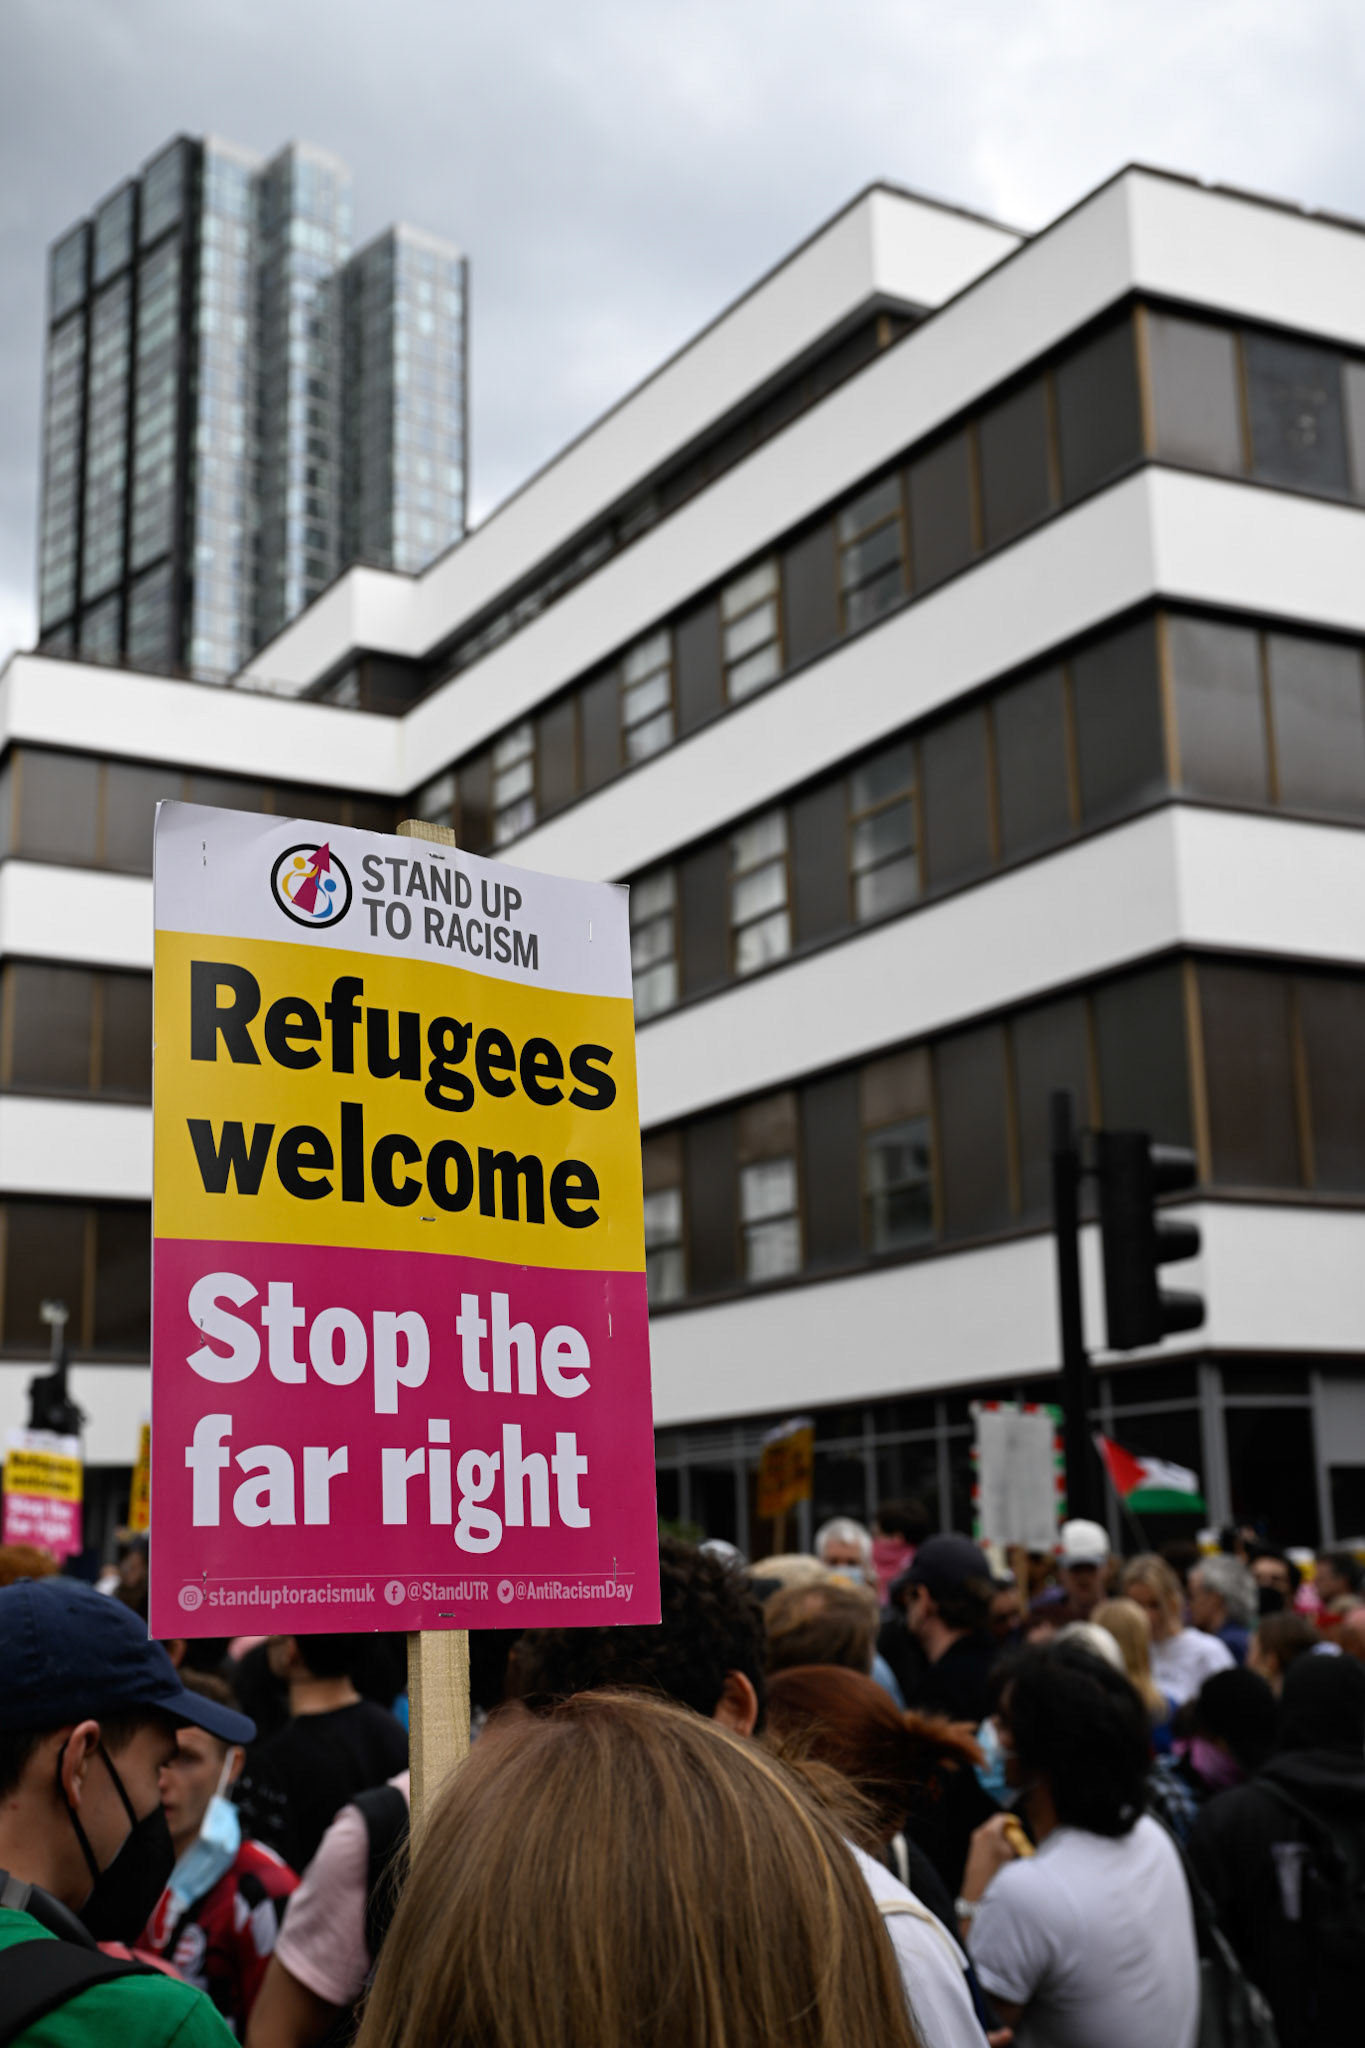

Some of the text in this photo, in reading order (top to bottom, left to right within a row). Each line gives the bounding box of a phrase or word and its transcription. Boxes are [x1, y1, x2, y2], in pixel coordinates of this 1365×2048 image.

[362, 854, 522, 922] STAND UP
[362, 897, 539, 970] TO RACISM
[190, 960, 617, 1112] Refugees
[187, 1101, 600, 1229] welcome
[186, 1272, 591, 1414] Stop the
[185, 1414, 348, 1527] far
[382, 1419, 591, 1554] right
[208, 1579, 634, 1608] standuptoracismuk @StandUTR @AntiRacismDay
